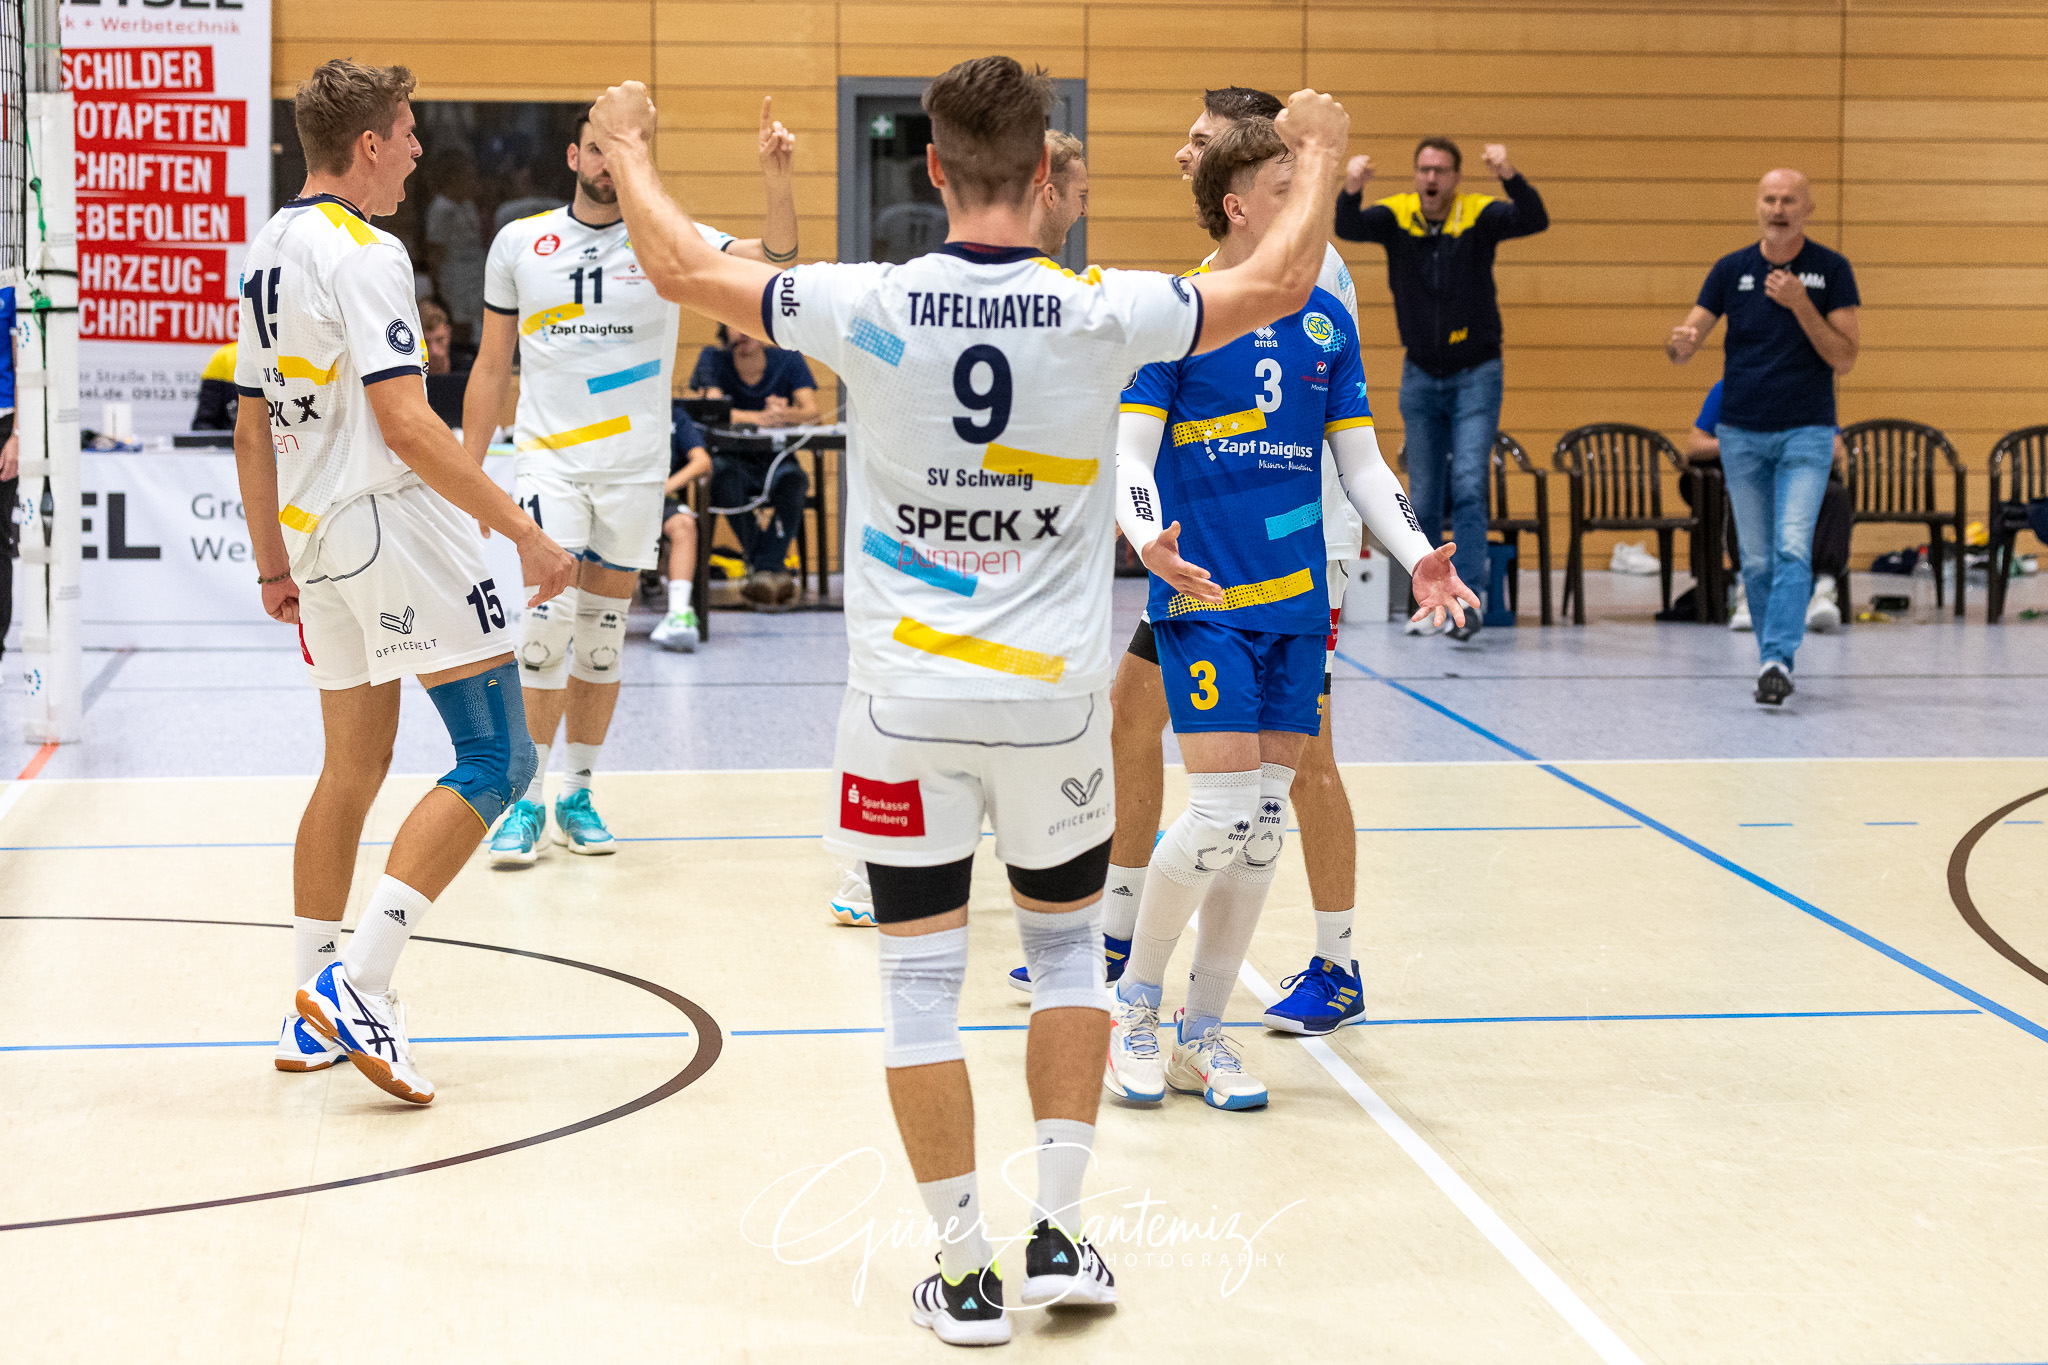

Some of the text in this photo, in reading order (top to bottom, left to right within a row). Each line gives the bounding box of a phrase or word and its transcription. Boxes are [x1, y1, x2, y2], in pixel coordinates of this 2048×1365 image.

[101, 16, 240, 34] Werbetechnik
[61, 51, 203, 90] SCHILDER
[569, 266, 603, 305] 11
[908, 292, 1062, 329] TAFELMAYER
[550, 324, 634, 336] Zapf Daigfuss
[1254, 340, 1278, 348] errea
[952, 344, 1013, 444] 9
[1254, 358, 1283, 413] 3
[1218, 439, 1313, 459] Zapf Daigfuss
[927, 467, 1033, 491] SV Schwaig
[896, 503, 1022, 542] SPECK
[897, 540, 1021, 580] pumpen
[466, 578, 506, 634] 15
[1190, 660, 1219, 711] 3
[861, 795, 910, 812] Sparkasse
[862, 810, 908, 827] Nürnberg
[1259, 815, 1281, 824] errea
[384, 910, 407, 927] adidas
